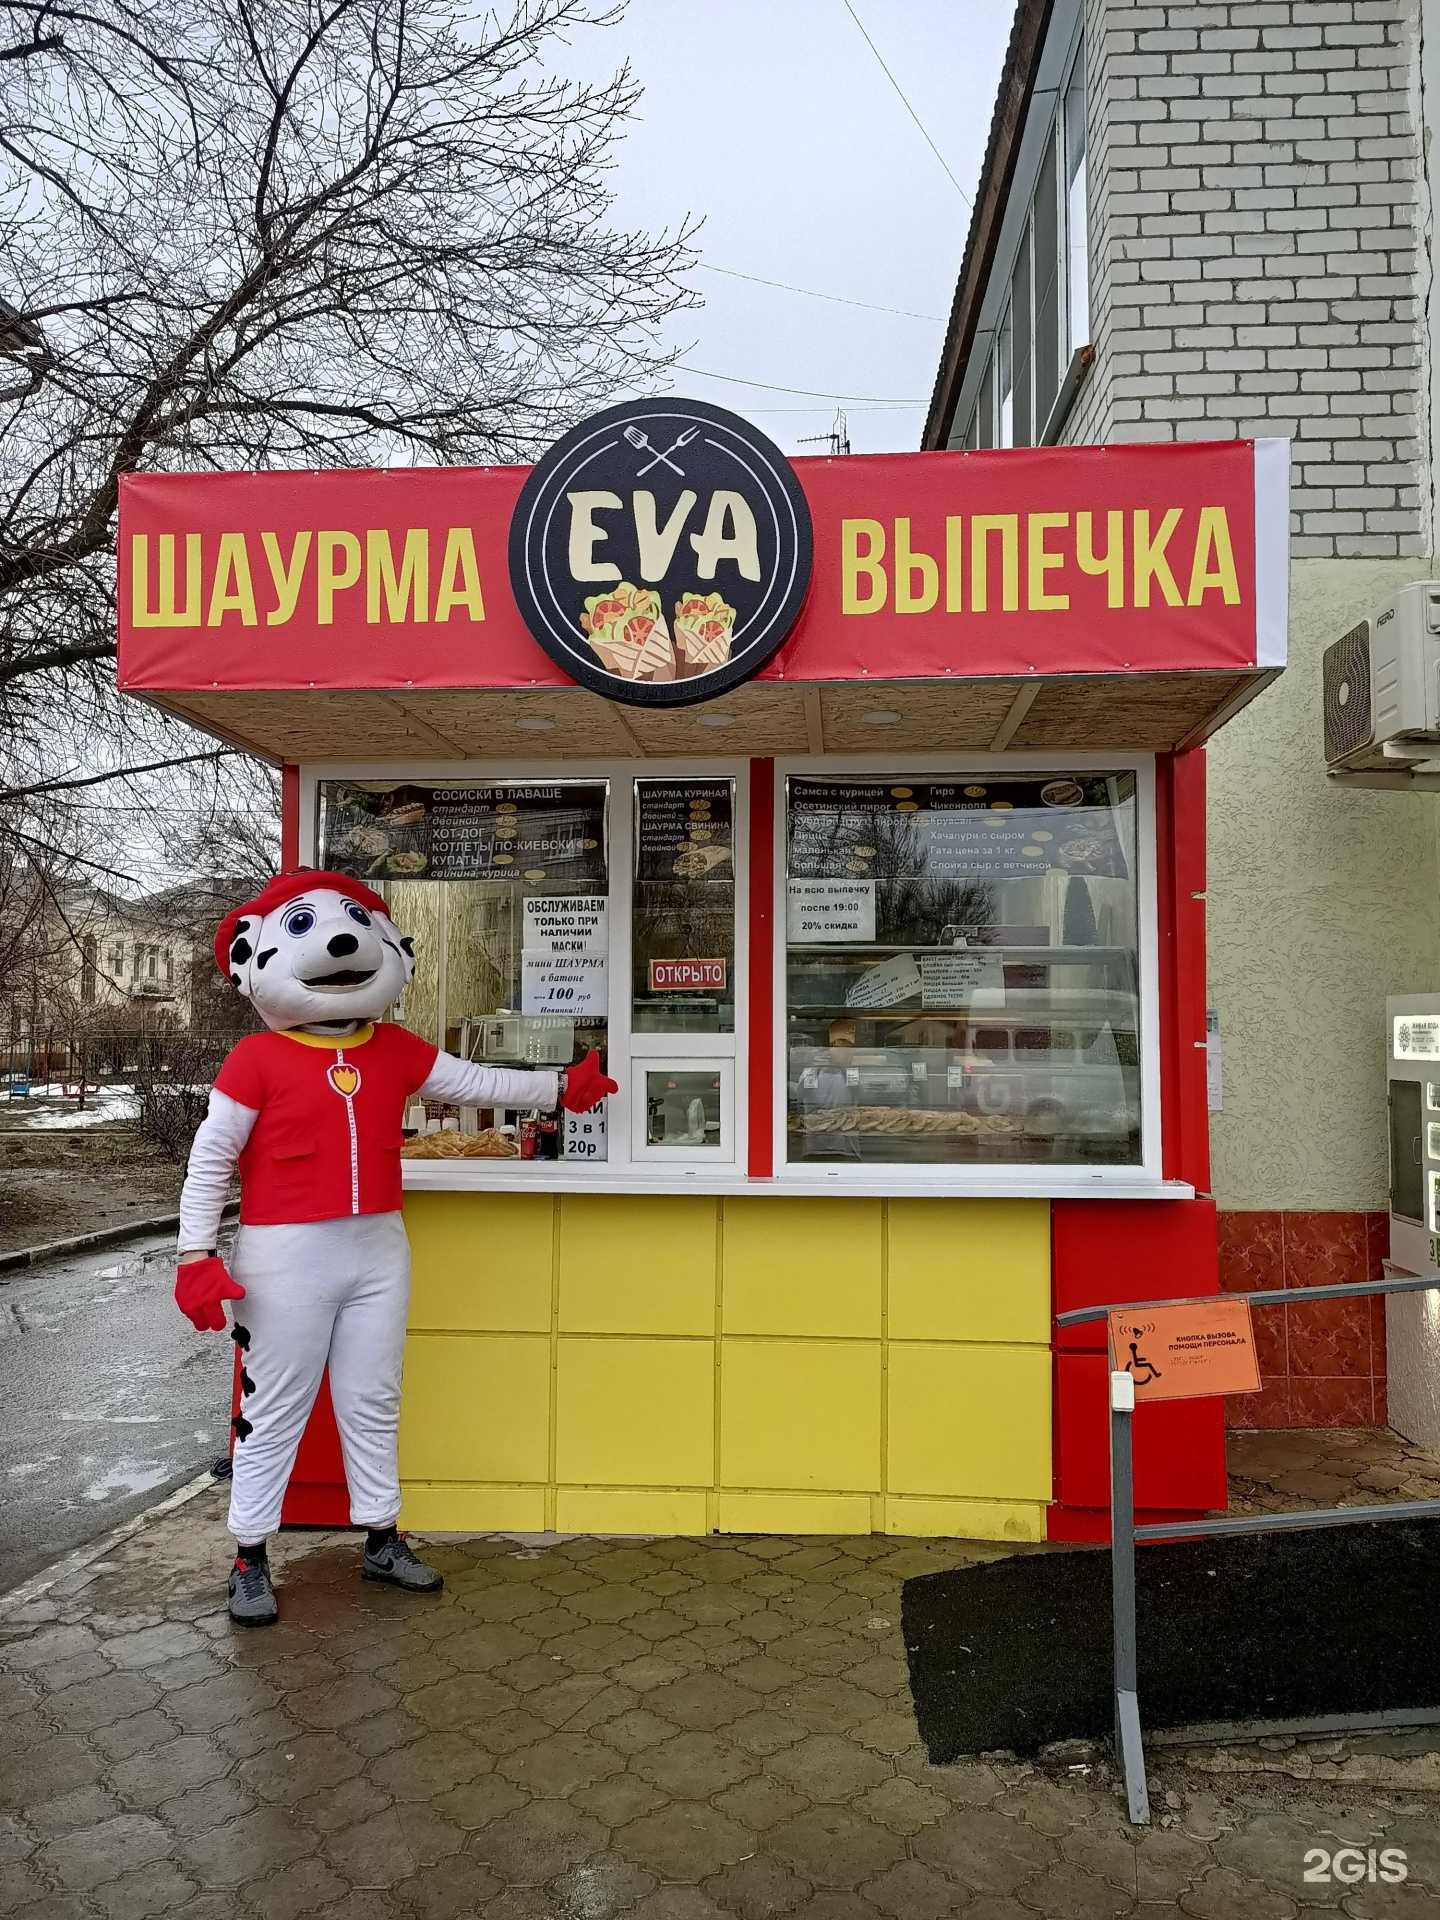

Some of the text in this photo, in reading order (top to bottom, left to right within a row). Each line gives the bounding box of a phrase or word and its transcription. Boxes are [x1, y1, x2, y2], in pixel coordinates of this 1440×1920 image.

[566, 489, 761, 583] EVA
[841, 506, 1241, 615] ВЫПЕЧКА
[132, 527, 485, 627] ШАУРМА
[432, 787, 562, 801] СОСИСКИ В ЛАВАШЕ
[642, 789, 728, 799] ШАУРМА КУРИНАЯ
[794, 786, 884, 797] Самса с курицей
[930, 786, 955, 797] Гиро
[432, 803, 490, 814] стандарт
[794, 801, 890, 812] Осетинский пирог
[642, 821, 730, 831] ШАУРМА СВИНИНА
[431, 828, 485, 840] ХОТ-ДОГ
[930, 831, 979, 841] Хачапури
[990, 832, 1025, 841] сыром
[431, 839, 575, 852] КОТЛЕТЫ ПО-КИЕВСКИ
[930, 845, 953, 855] Гата
[955, 847, 979, 856] цена
[982, 847, 993, 855] за
[431, 854, 483, 866] КУПАТЫ
[971, 861, 992, 871] сыр
[482, 868, 520, 879] курица
[789, 886, 802, 894] На
[828, 886, 870, 895] выпечку
[527, 899, 605, 913] ОБСЛУЖИВАЕМ
[801, 903, 859, 912] после 19:00
[534, 916, 598, 927] ТОЛЬКО ПРИ
[802, 921, 858, 931] 20% скидка
[540, 928, 592, 937] НАЛИЧИИ
[551, 941, 587, 952] МАСКИ!
[527, 958, 604, 968] мини ШАУРМА
[548, 973, 585, 982] батоне
[655, 965, 722, 983] ОТКРЫТО
[548, 987, 574, 1000] 100
[577, 993, 592, 1001] руб
[569, 1120, 605, 1134] 3 в 1
[568, 1140, 597, 1157] 20р
[1176, 1331, 1237, 1343] КНОПКА ВЫЗОВА
[1168, 1337, 1247, 1351] ПОМОЩИ ПЕРСОНАЛА
